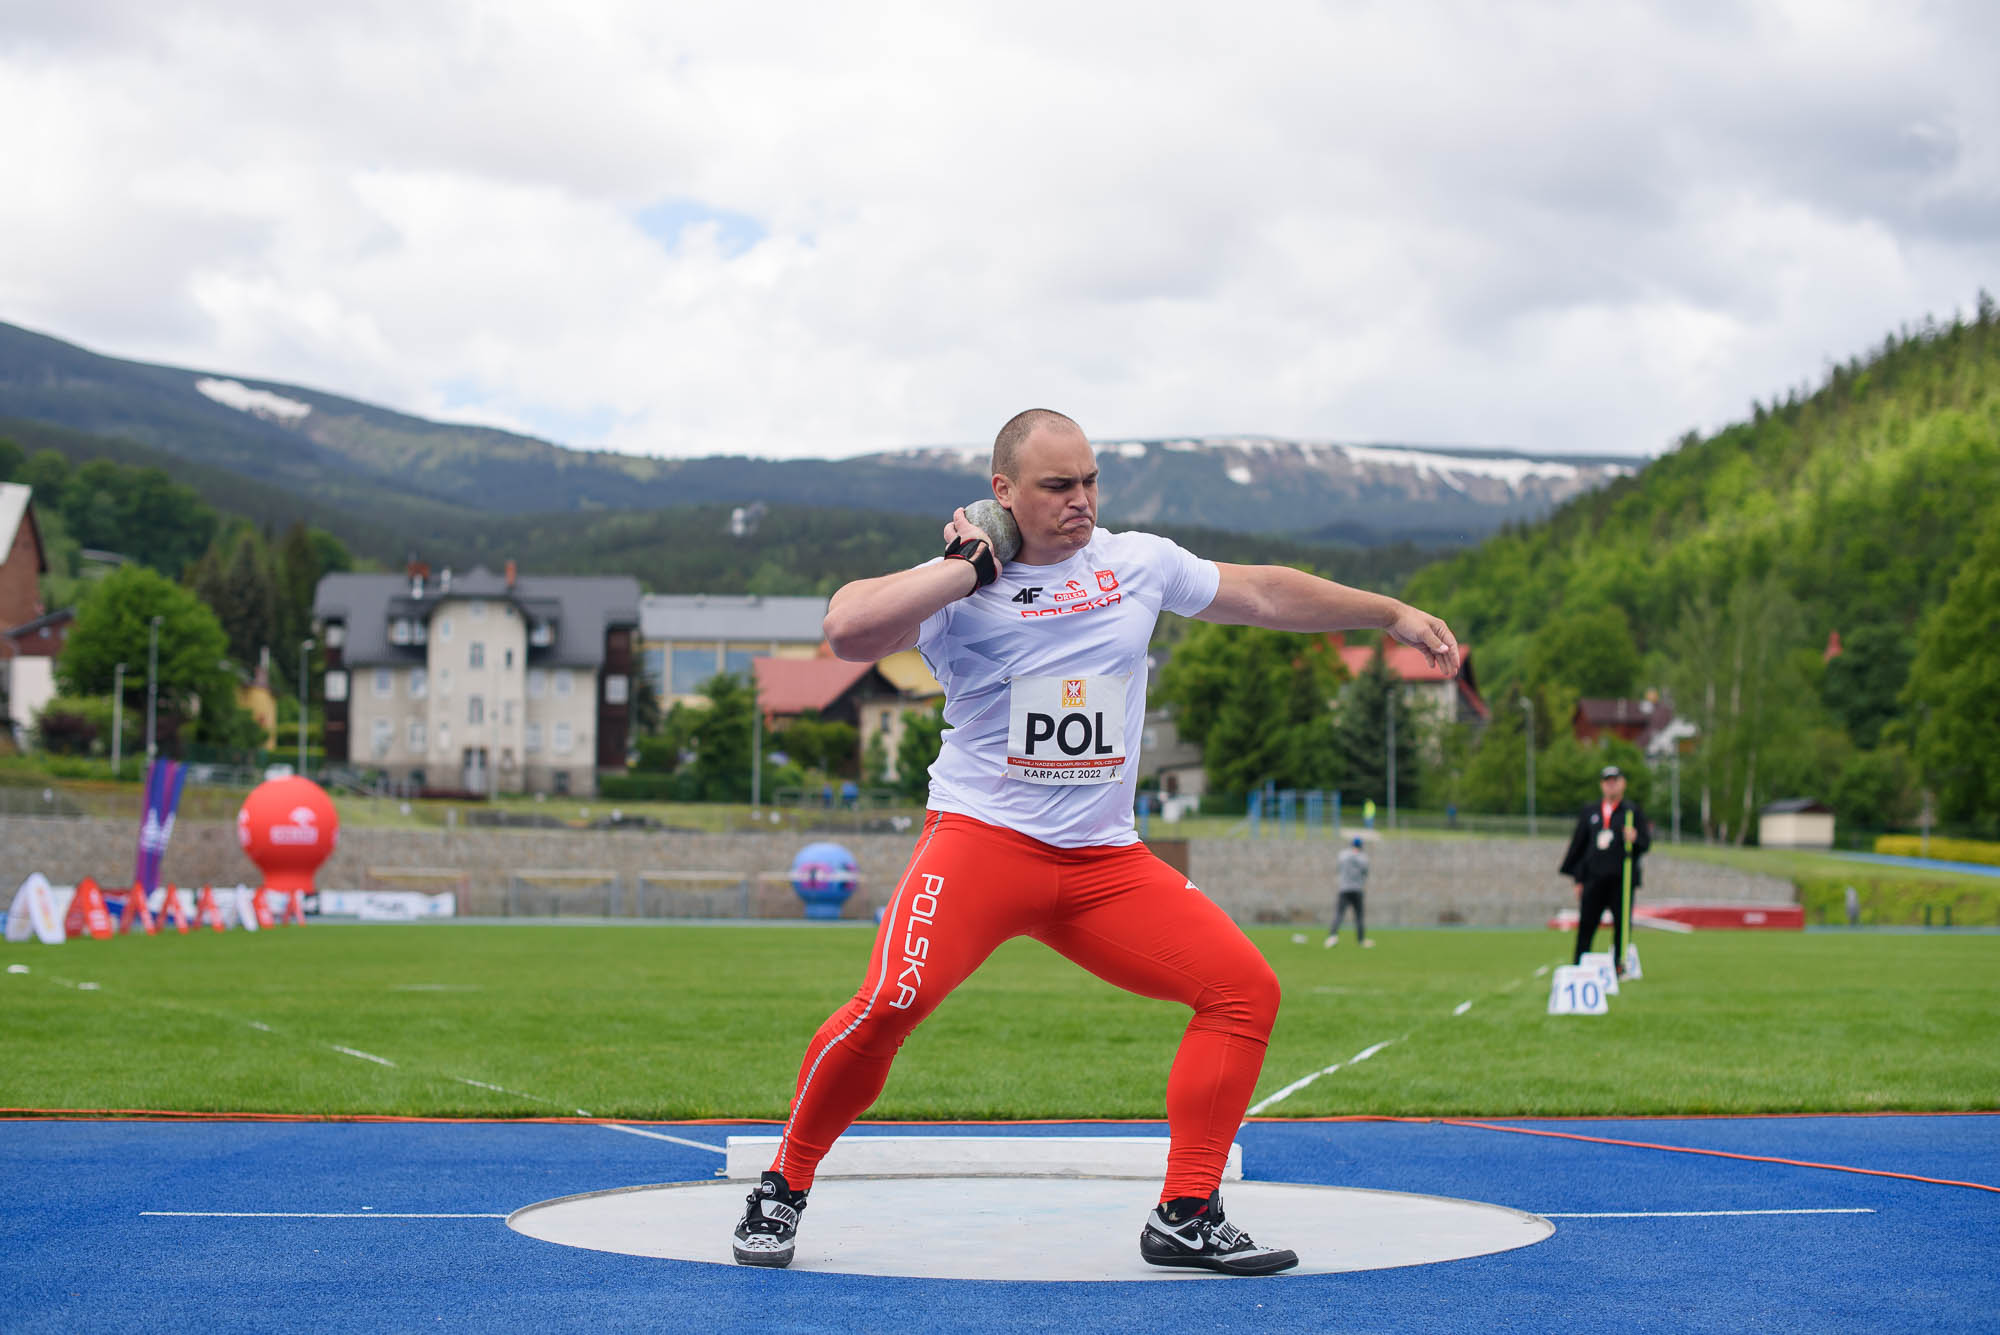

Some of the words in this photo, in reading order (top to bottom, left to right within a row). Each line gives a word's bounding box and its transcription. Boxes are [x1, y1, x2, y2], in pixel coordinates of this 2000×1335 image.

[1012, 587, 1043, 604] 4F
[1021, 593, 1122, 618] POLSKA
[1056, 590, 1086, 601] ORLEN
[1025, 712, 1113, 756] POL
[1023, 768, 1075, 779] KARPACZ
[1078, 769, 1101, 779] 2022
[888, 873, 945, 1010] POLSKA
[1564, 983, 1599, 1009] 10
